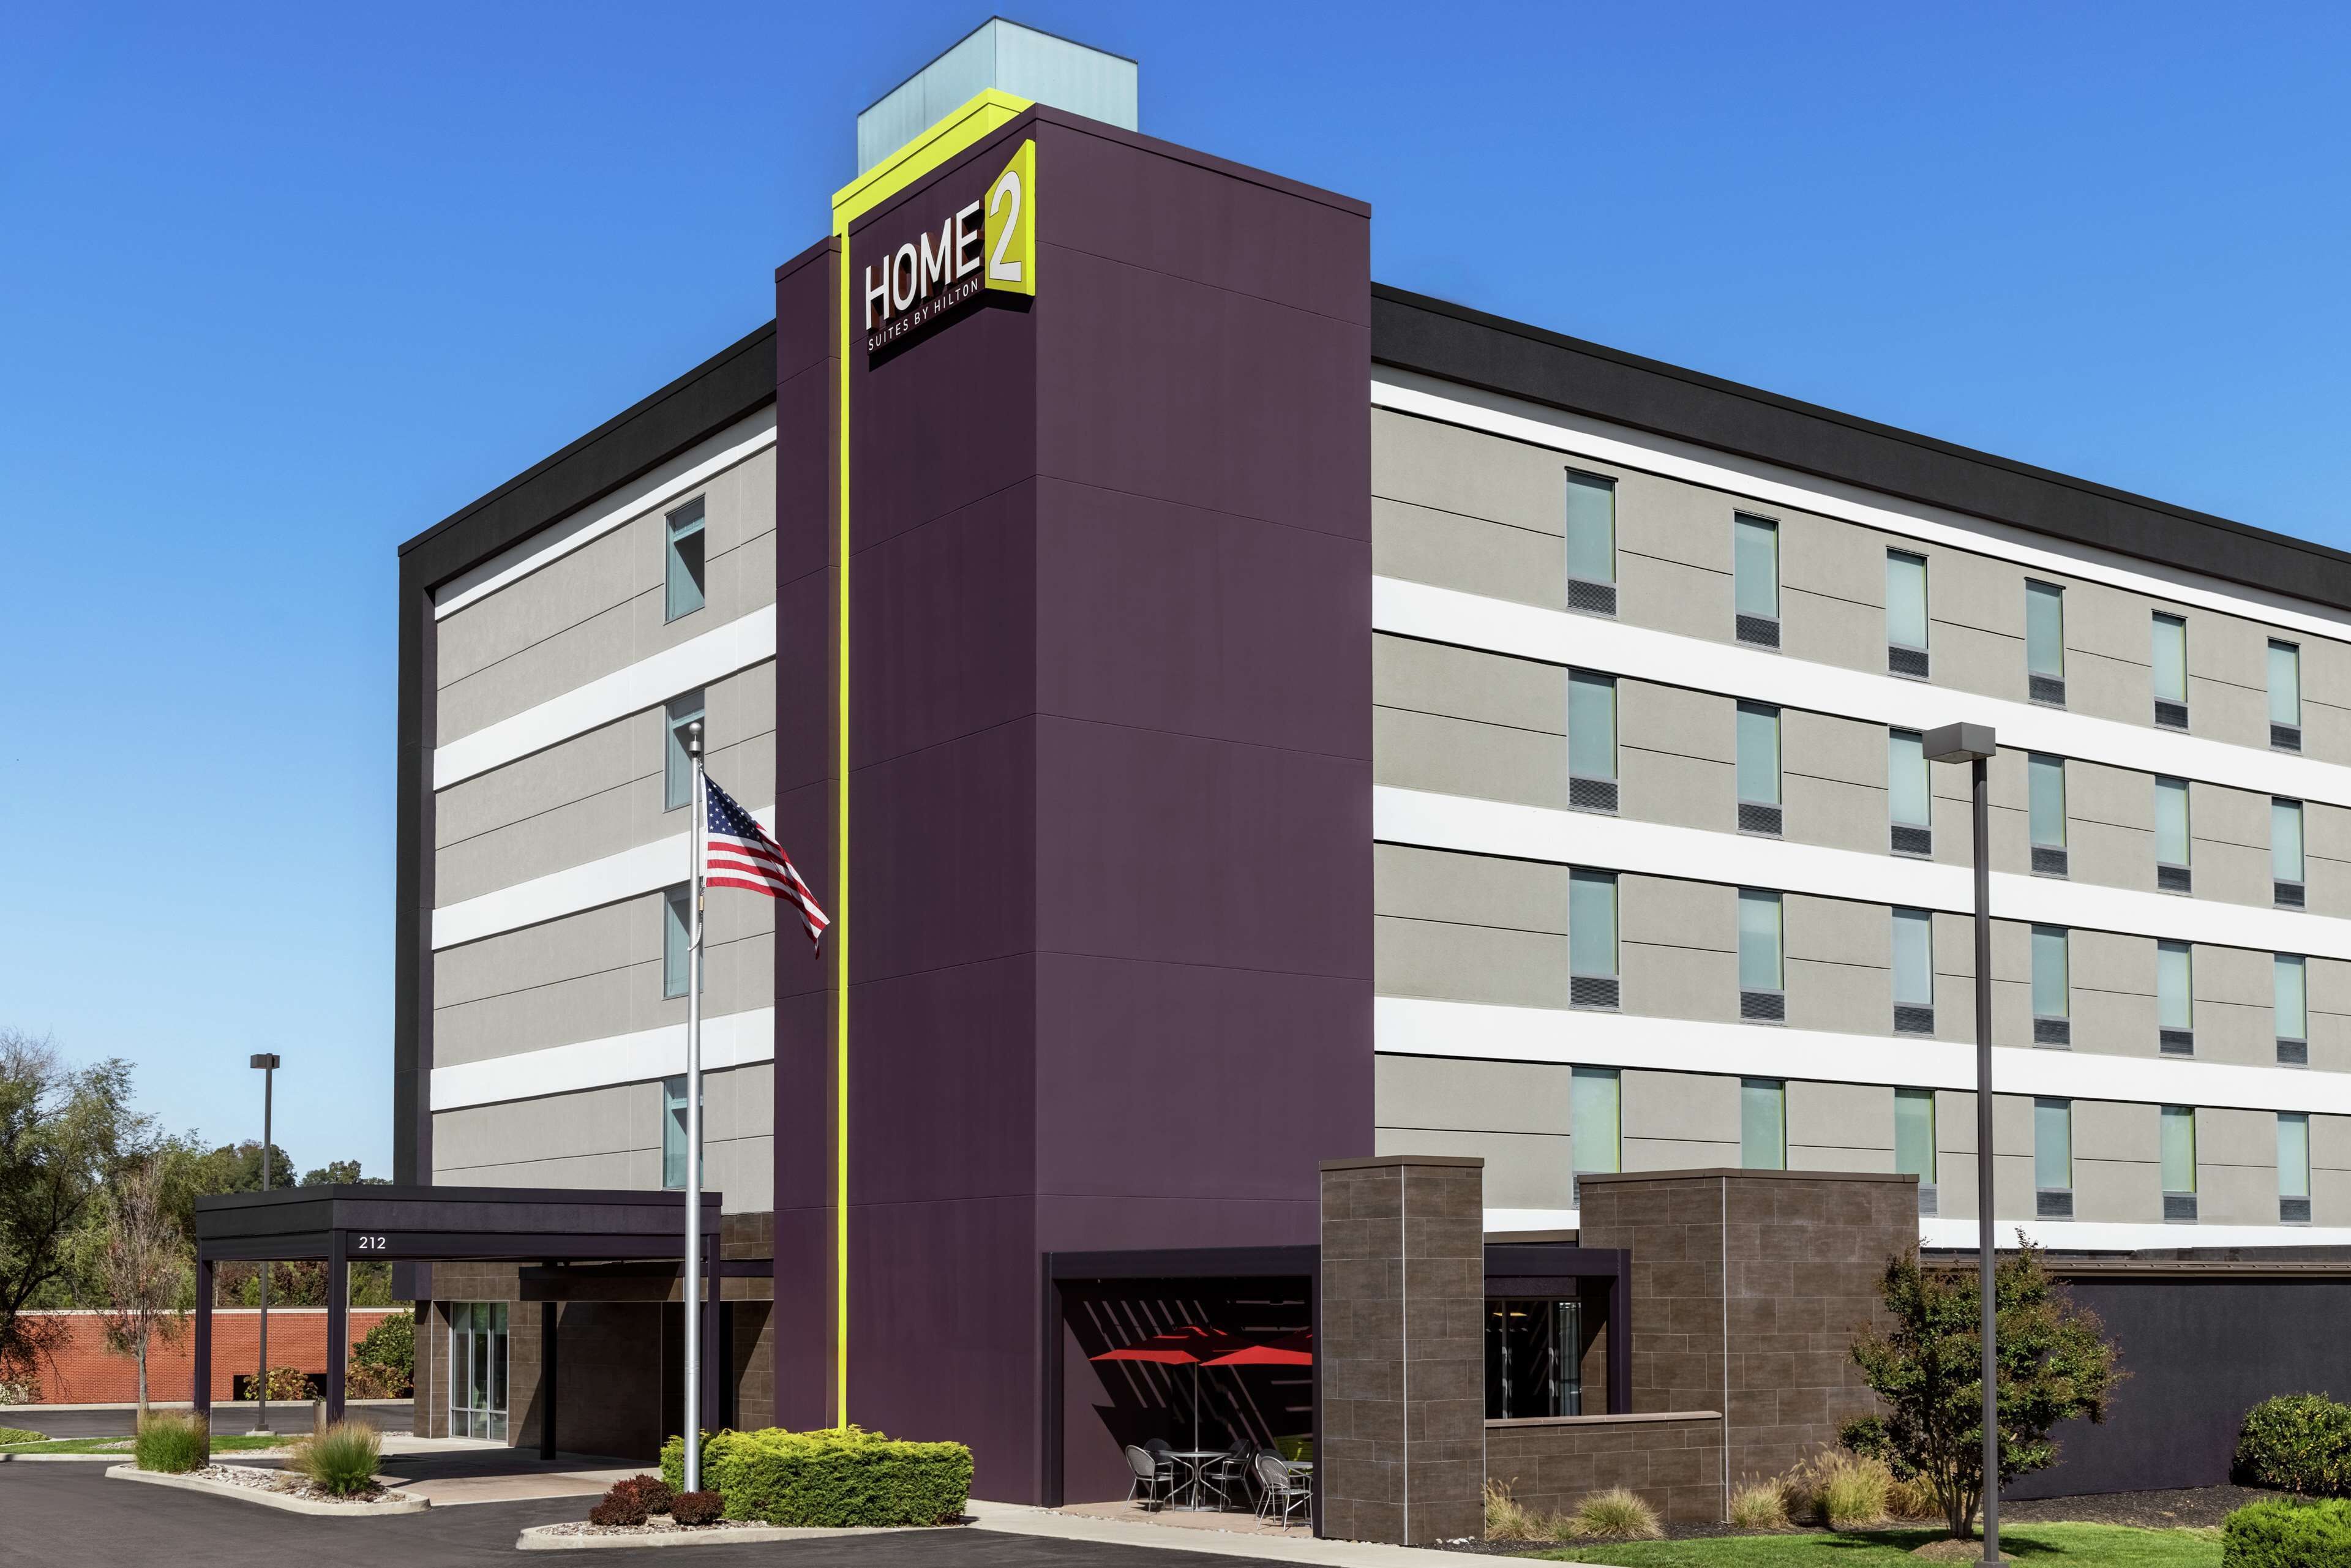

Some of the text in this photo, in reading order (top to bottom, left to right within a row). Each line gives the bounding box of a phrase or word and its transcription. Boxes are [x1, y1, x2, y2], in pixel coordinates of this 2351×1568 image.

[866, 170, 1022, 331] HOME 2
[868, 278, 978, 351] SUITES BY HILTON
[358, 1236, 386, 1249] 212
